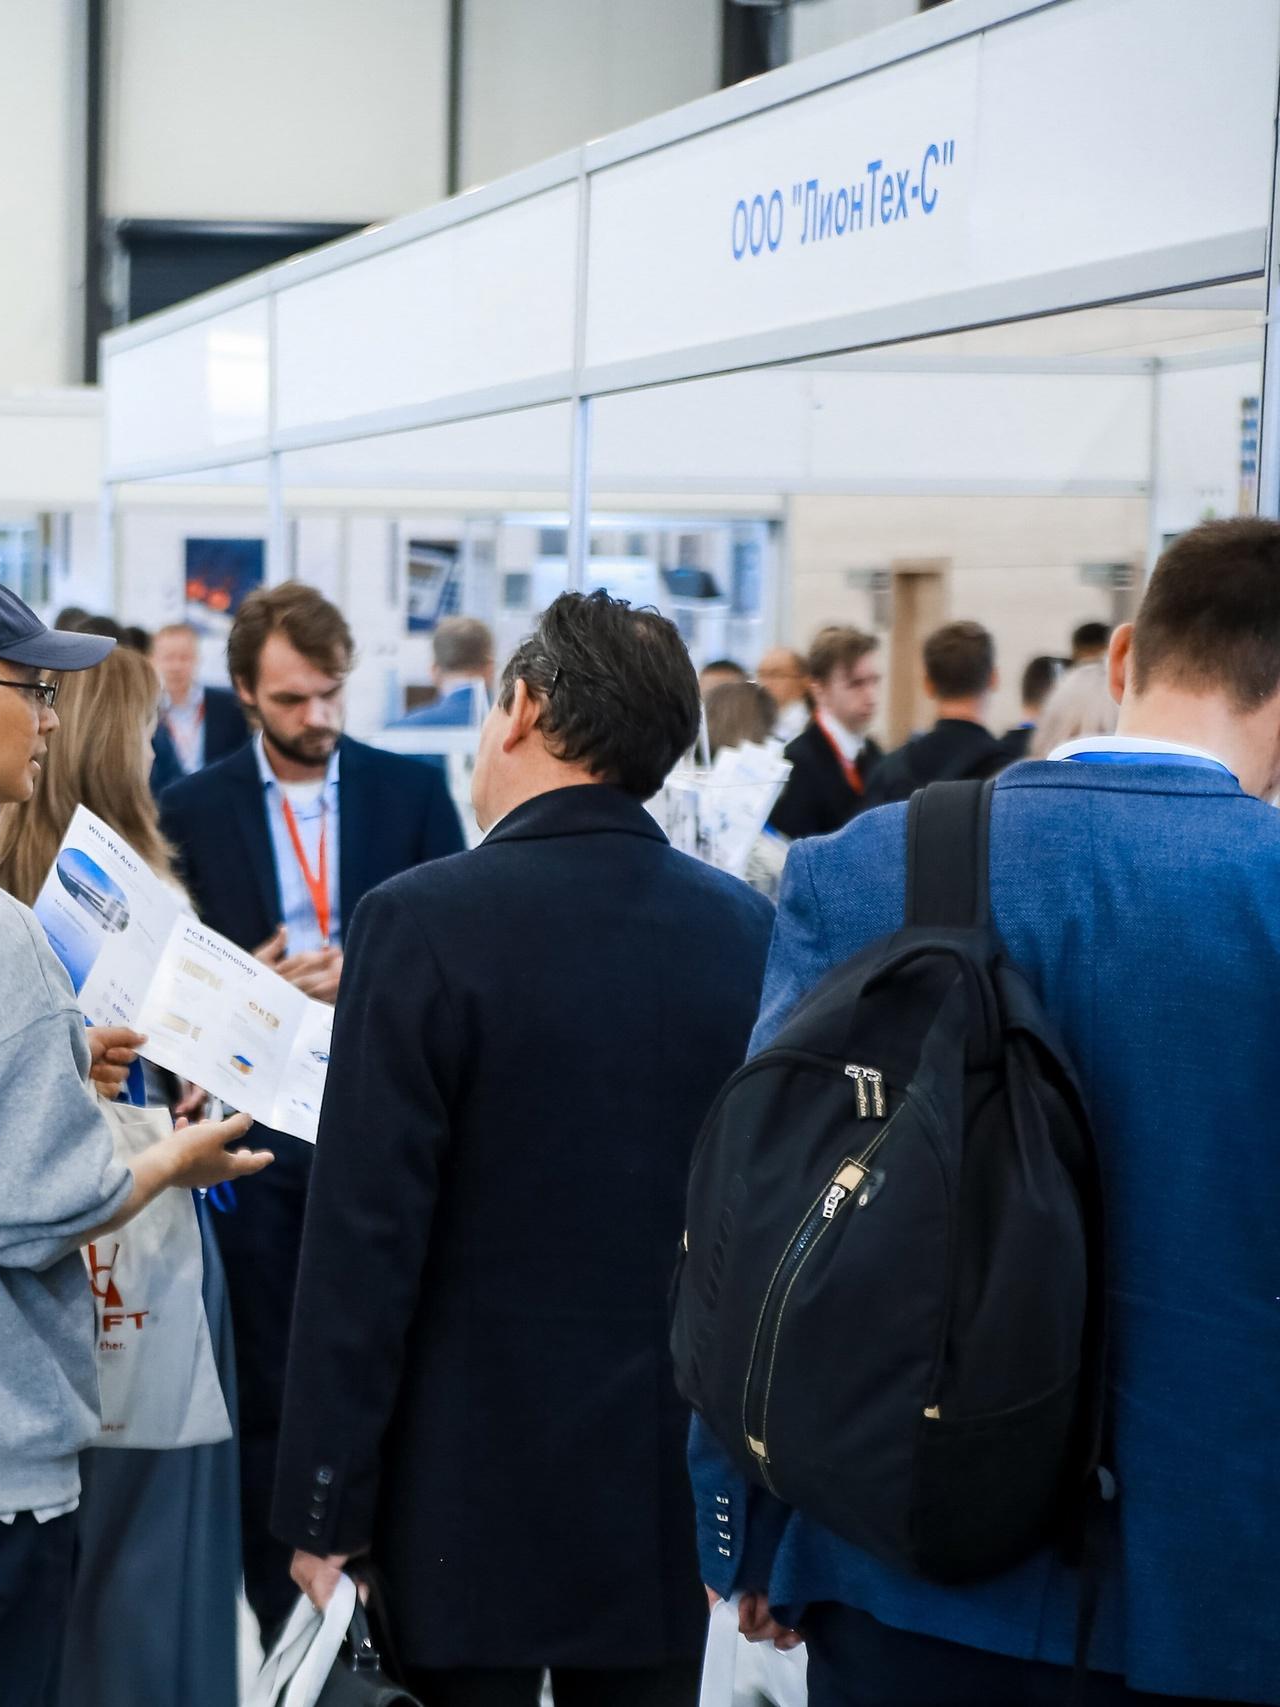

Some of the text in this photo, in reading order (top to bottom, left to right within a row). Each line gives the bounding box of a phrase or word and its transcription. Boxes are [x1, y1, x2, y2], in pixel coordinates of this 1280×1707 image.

[732, 139, 955, 261] ООО "ЛионТех-С"
[89, 824, 138, 872] Who We Are?
[185, 928, 205, 943] PCB
[207, 939, 258, 978] Technology
